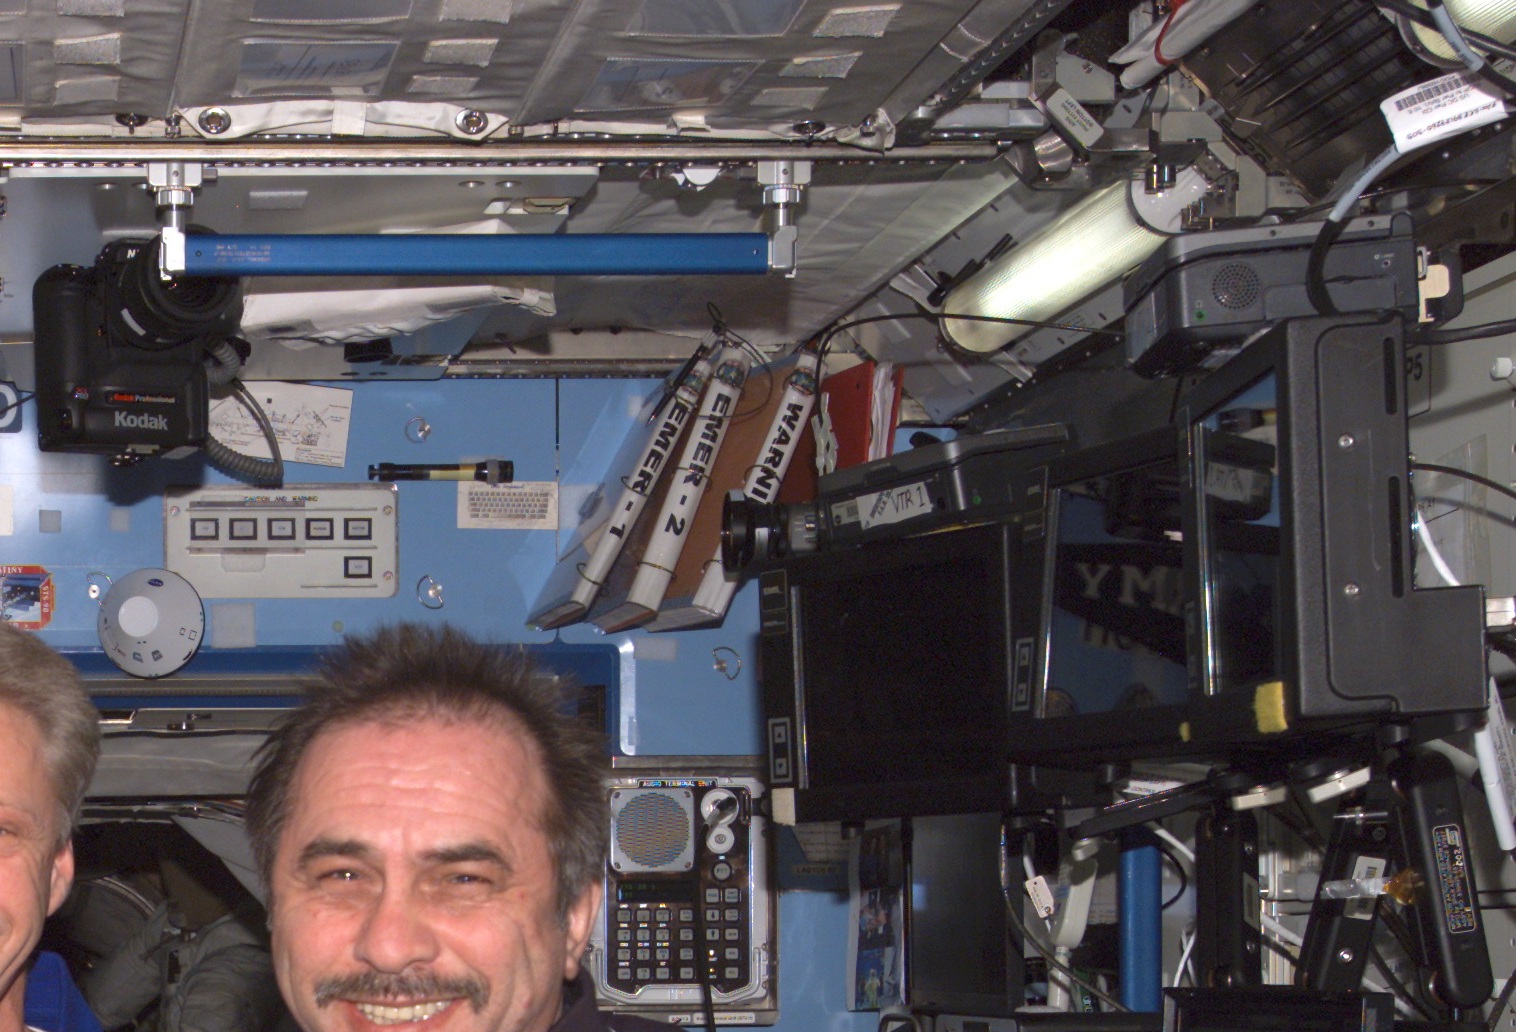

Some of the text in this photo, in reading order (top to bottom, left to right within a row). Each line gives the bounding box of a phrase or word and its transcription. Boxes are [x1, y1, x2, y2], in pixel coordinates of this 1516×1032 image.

[114, 411, 168, 431] Kodak
[683, 393, 732, 488] EMER
[632, 407, 687, 494] EMER
[751, 402, 804, 500] WARNI
[665, 513, 686, 538] 2
[890, 489, 914, 513] VTR
